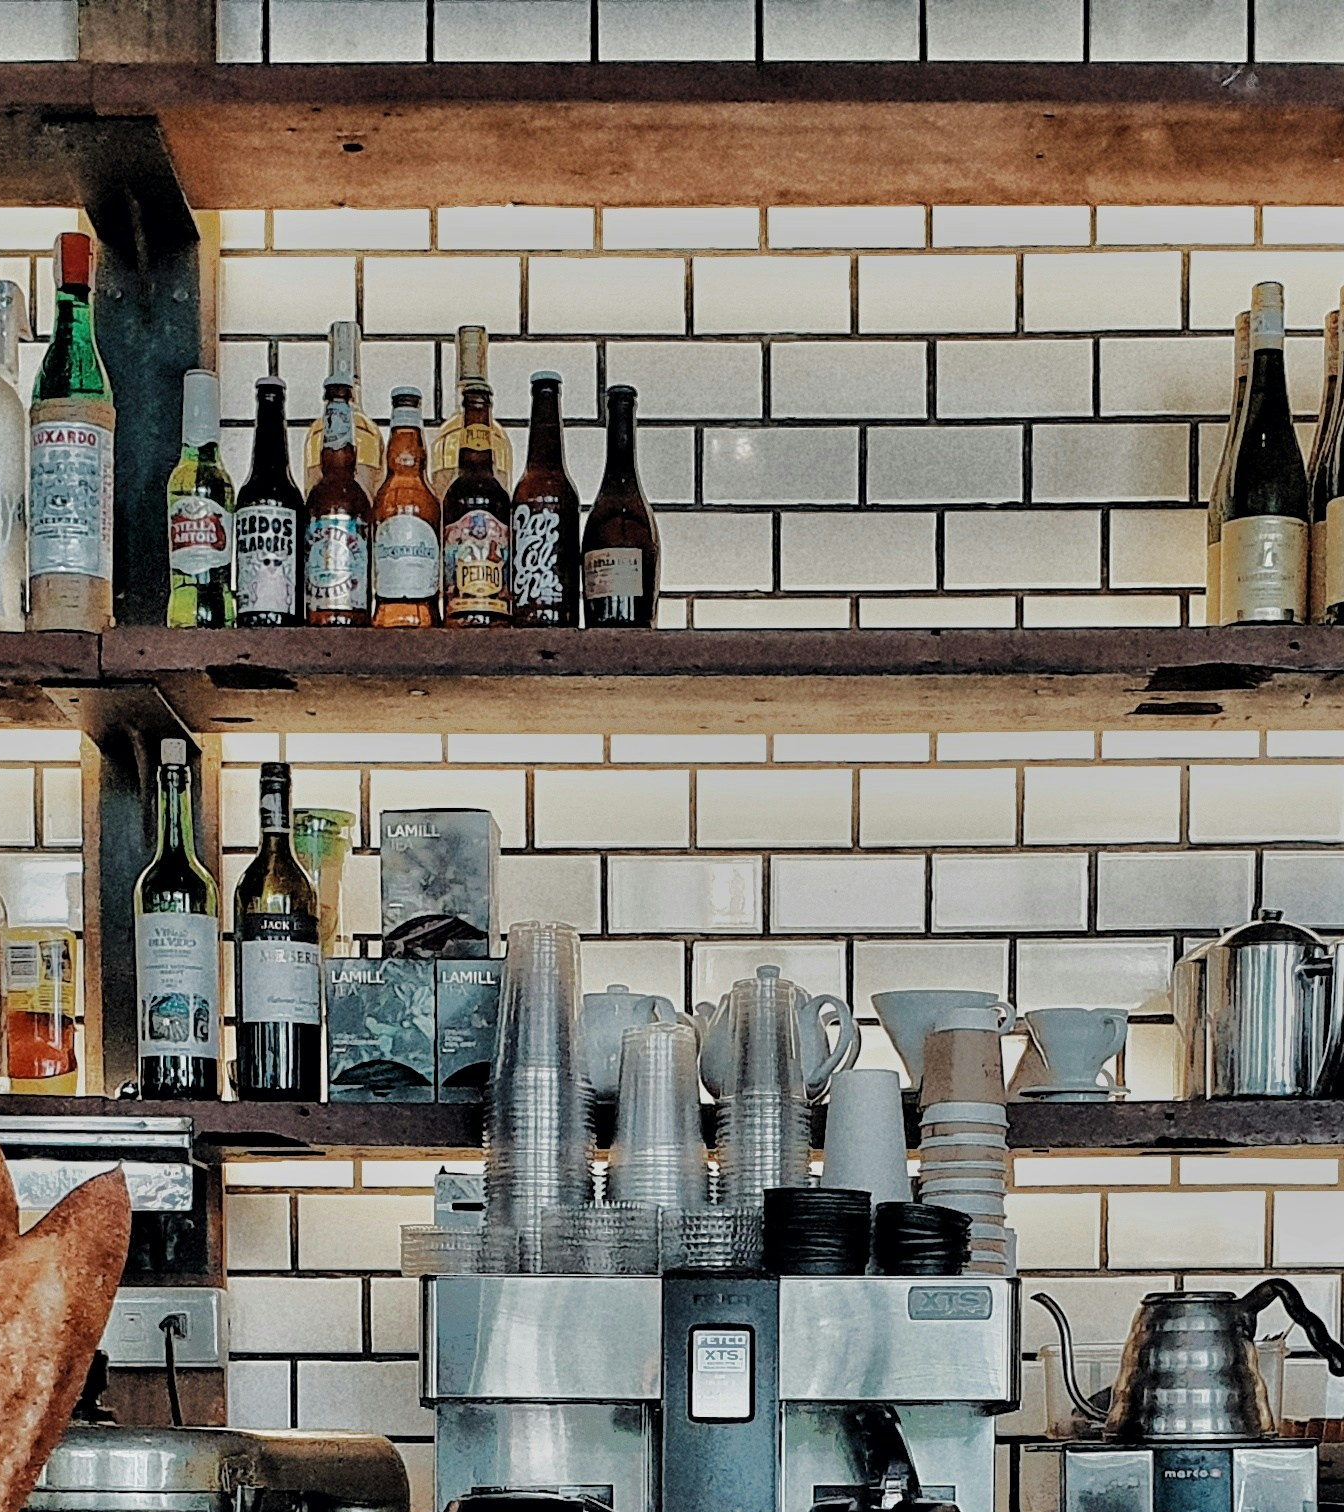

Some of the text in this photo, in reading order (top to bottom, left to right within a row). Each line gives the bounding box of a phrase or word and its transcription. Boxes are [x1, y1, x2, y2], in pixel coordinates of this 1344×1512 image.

[33, 430, 96, 447] LUXARDO
[172, 520, 216, 532] STELLA
[174, 532, 218, 544] ARTOIS
[462, 566, 501, 588] PEDRO
[386, 823, 441, 840] LAMILL
[260, 919, 290, 931] JACK
[331, 970, 386, 986] LAMILL
[442, 970, 497, 986] LAMILL
[697, 1335, 747, 1346] FETCO
[705, 1349, 739, 1361] XTS
[1164, 1467, 1210, 1481] marco
